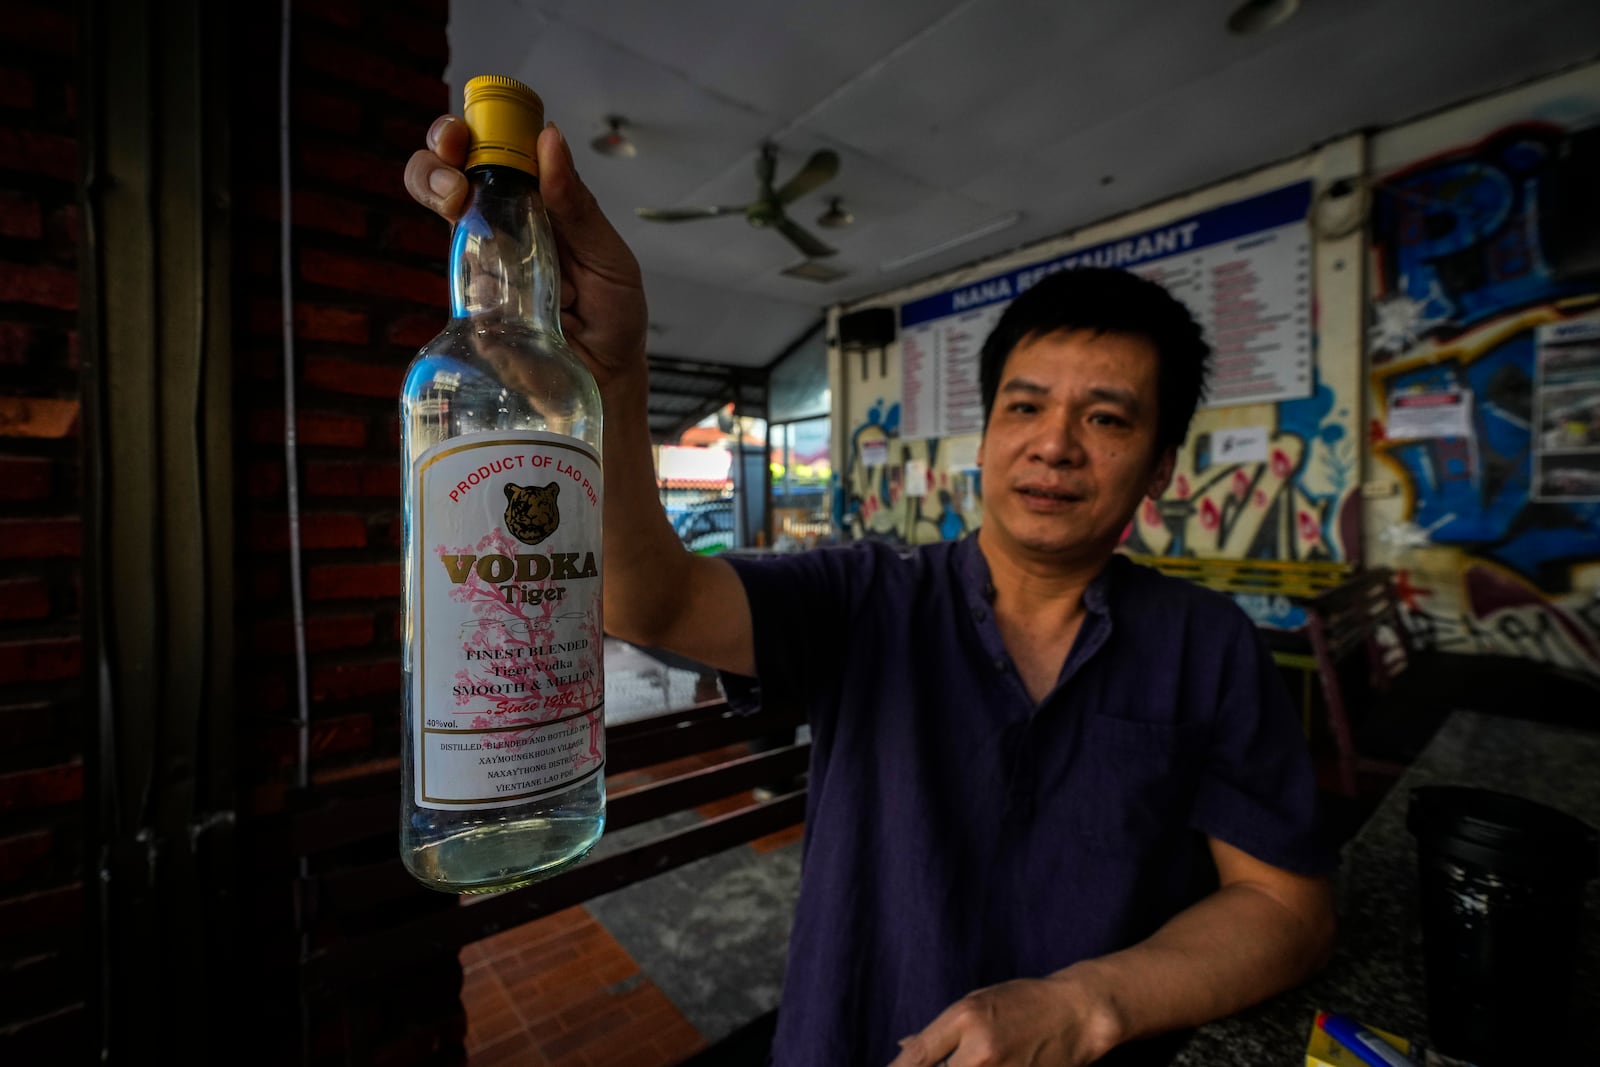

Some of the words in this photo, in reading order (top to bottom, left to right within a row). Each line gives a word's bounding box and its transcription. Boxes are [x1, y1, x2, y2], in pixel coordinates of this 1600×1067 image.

[952, 280, 1011, 310] NANA
[449, 455, 525, 503] PRODUCT
[531, 455, 553, 468] OF
[556, 460, 582, 481] LAO
[582, 479, 598, 506] PDR
[441, 552, 598, 584] VODKA
[499, 584, 566, 605] Tiger
[466, 648, 525, 660] FINEST
[529, 639, 588, 657] BLENDED
[492, 665, 530, 677] Tiger
[535, 659, 573, 673] Vodka
[452, 682, 525, 697] SMOOTH
[531, 681, 542, 690] &
[494, 700, 537, 715] Since
[543, 691, 574, 709] 1980
[440, 743, 485, 751] DISTILLED,
[487, 740, 528, 750] BLENDED
[529, 736, 545, 745] AND
[547, 727, 579, 741] BOTTLED
[557, 738, 584, 751] VILLAGE
[487, 763, 547, 779] NAXAYTHONG
[548, 753, 580, 769] DISTRICT
[496, 778, 542, 792] VIENTIANE
[544, 774, 559, 784] LAO
